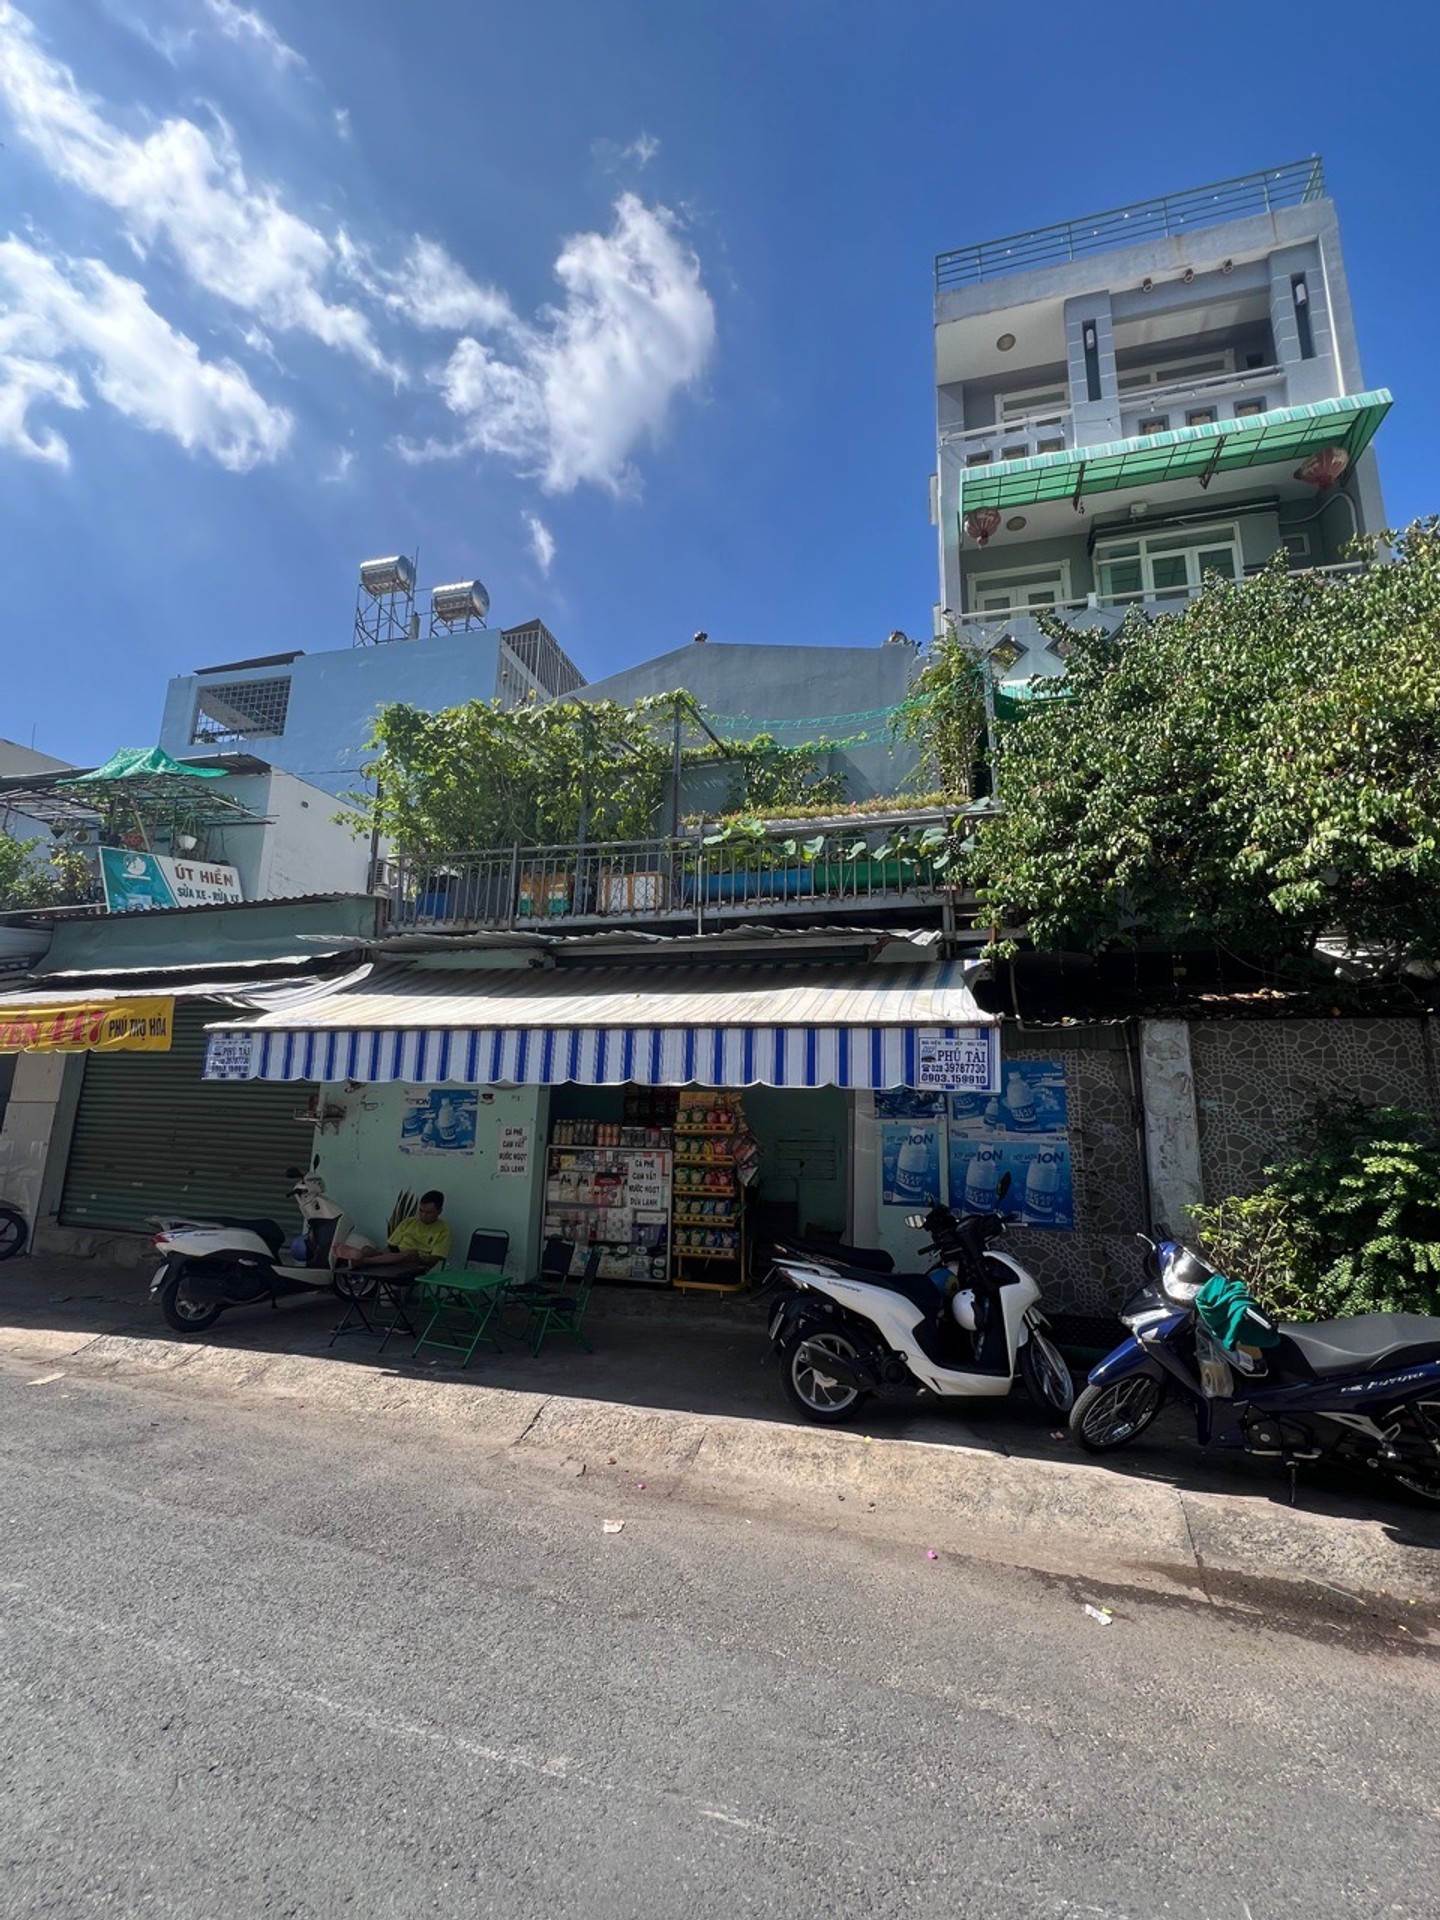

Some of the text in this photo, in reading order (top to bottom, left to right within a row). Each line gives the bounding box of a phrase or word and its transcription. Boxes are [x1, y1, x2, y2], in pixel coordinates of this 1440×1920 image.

[174, 863, 194, 881] ÚT
[195, 889, 206, 900] XE
[108, 1014, 127, 1038] PHÚ
[149, 1012, 166, 1037] HÒA
[937, 1047, 986, 1063] PHÚ TÀI
[944, 1062, 986, 1074] 39787730
[908, 1134, 934, 1145] ION
[976, 1149, 1003, 1162] ION
[1037, 1152, 1064, 1164] ION
